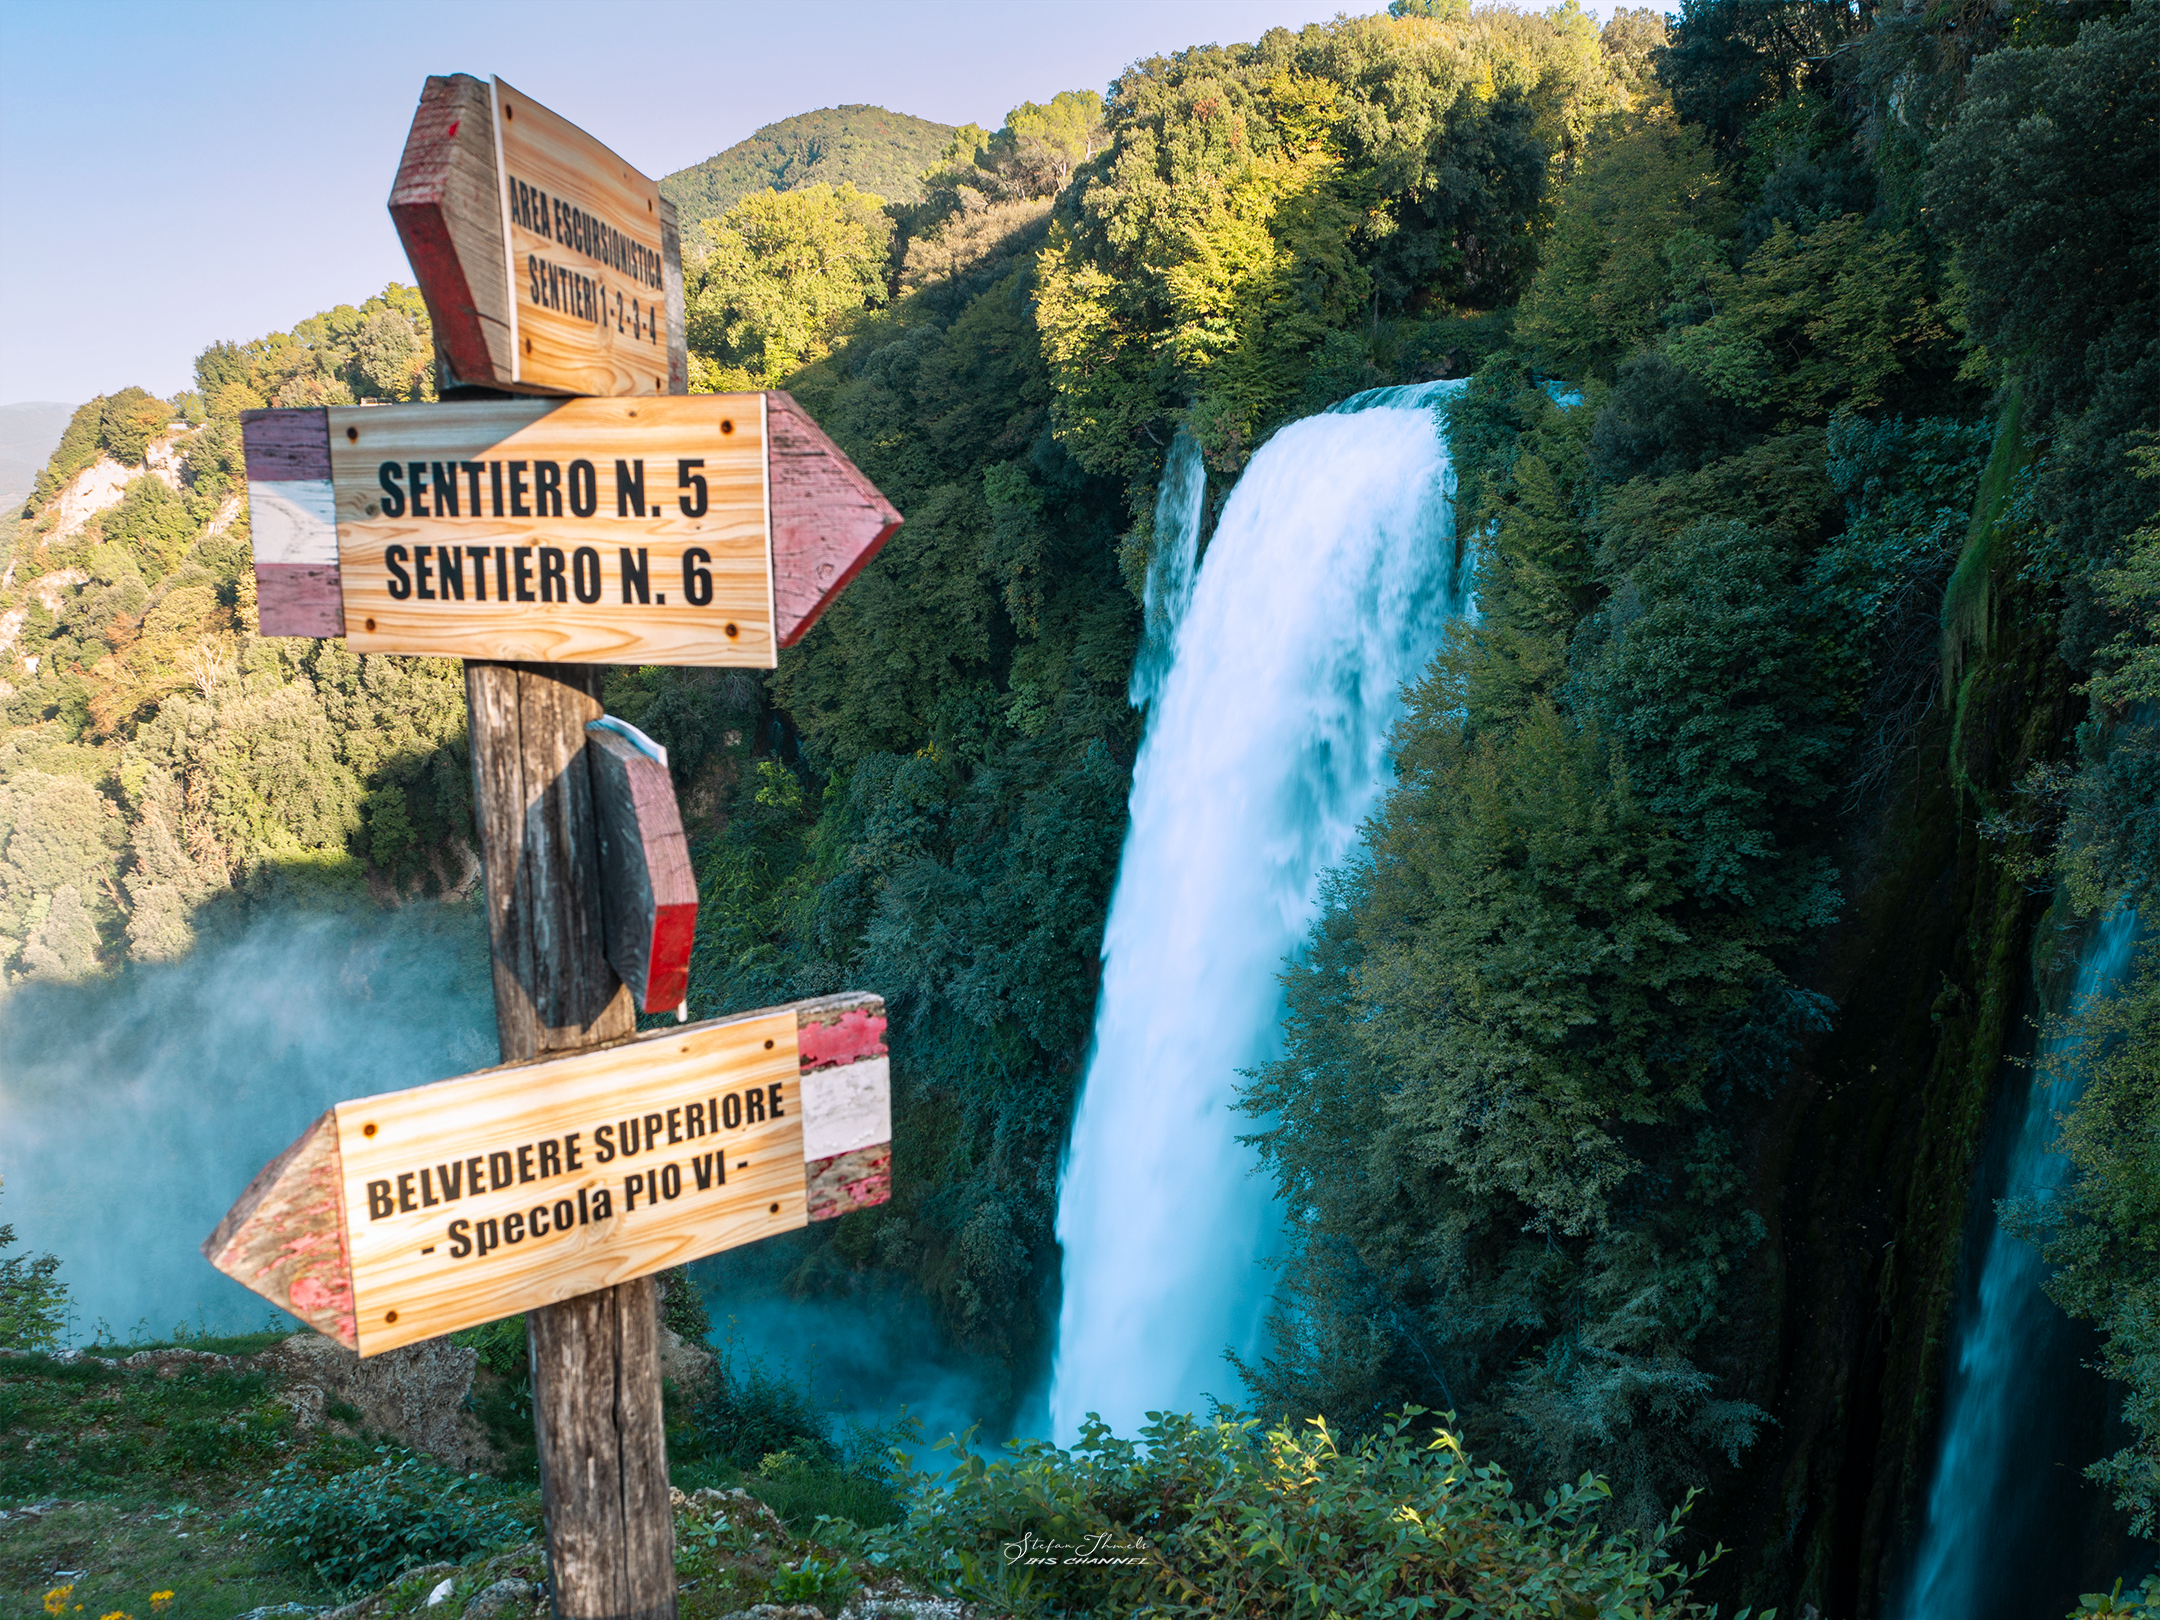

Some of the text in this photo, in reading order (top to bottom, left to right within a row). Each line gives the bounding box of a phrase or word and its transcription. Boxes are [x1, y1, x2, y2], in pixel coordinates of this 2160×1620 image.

[509, 175, 663, 291] AREA ESCURSIONISTICA
[528, 253, 598, 323] SENTIERI
[378, 459, 708, 518] SENTIERO N. 5
[385, 544, 713, 607] SENTIERO N. 6
[366, 1082, 785, 1221] BELVEDERE SUPERIORE
[448, 1186, 612, 1259] Specola
[624, 1163, 682, 1213] PIO
[692, 1150, 726, 1191] VI
